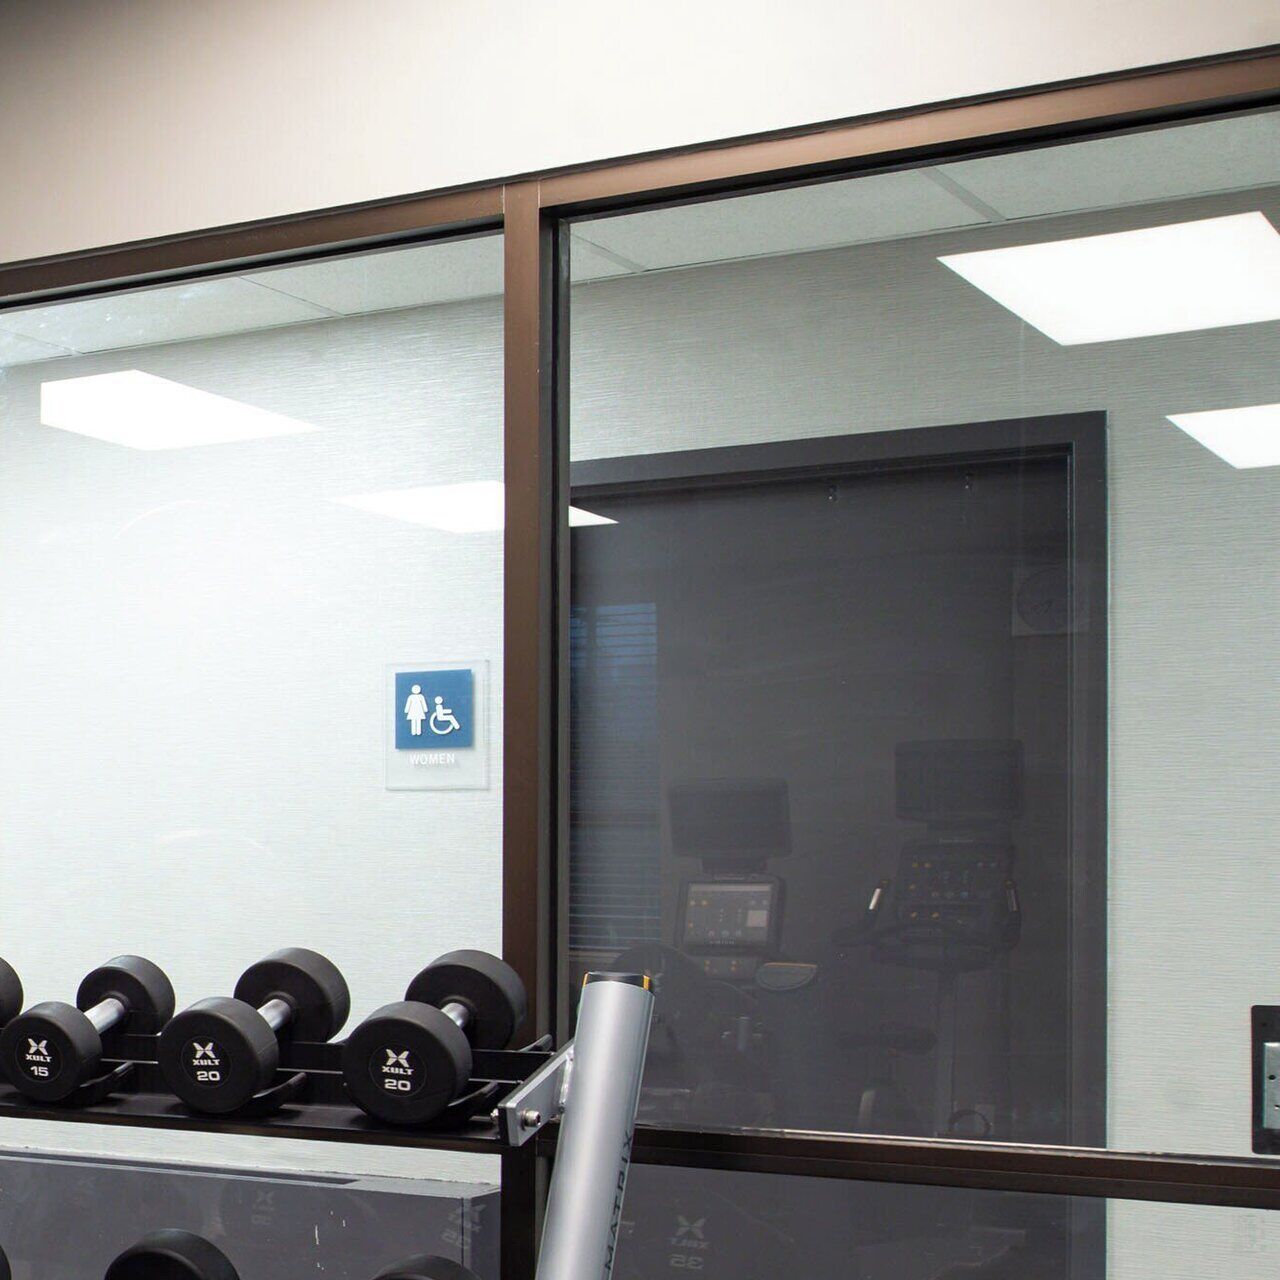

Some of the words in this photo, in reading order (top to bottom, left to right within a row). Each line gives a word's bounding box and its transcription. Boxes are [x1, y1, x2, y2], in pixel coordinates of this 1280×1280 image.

[409, 753, 455, 765] WOMEN
[26, 1054, 52, 1062] XULT
[30, 1066, 49, 1076] 15
[382, 1066, 413, 1075] XULT
[197, 1071, 220, 1081] 20
[385, 1079, 411, 1091] 20
